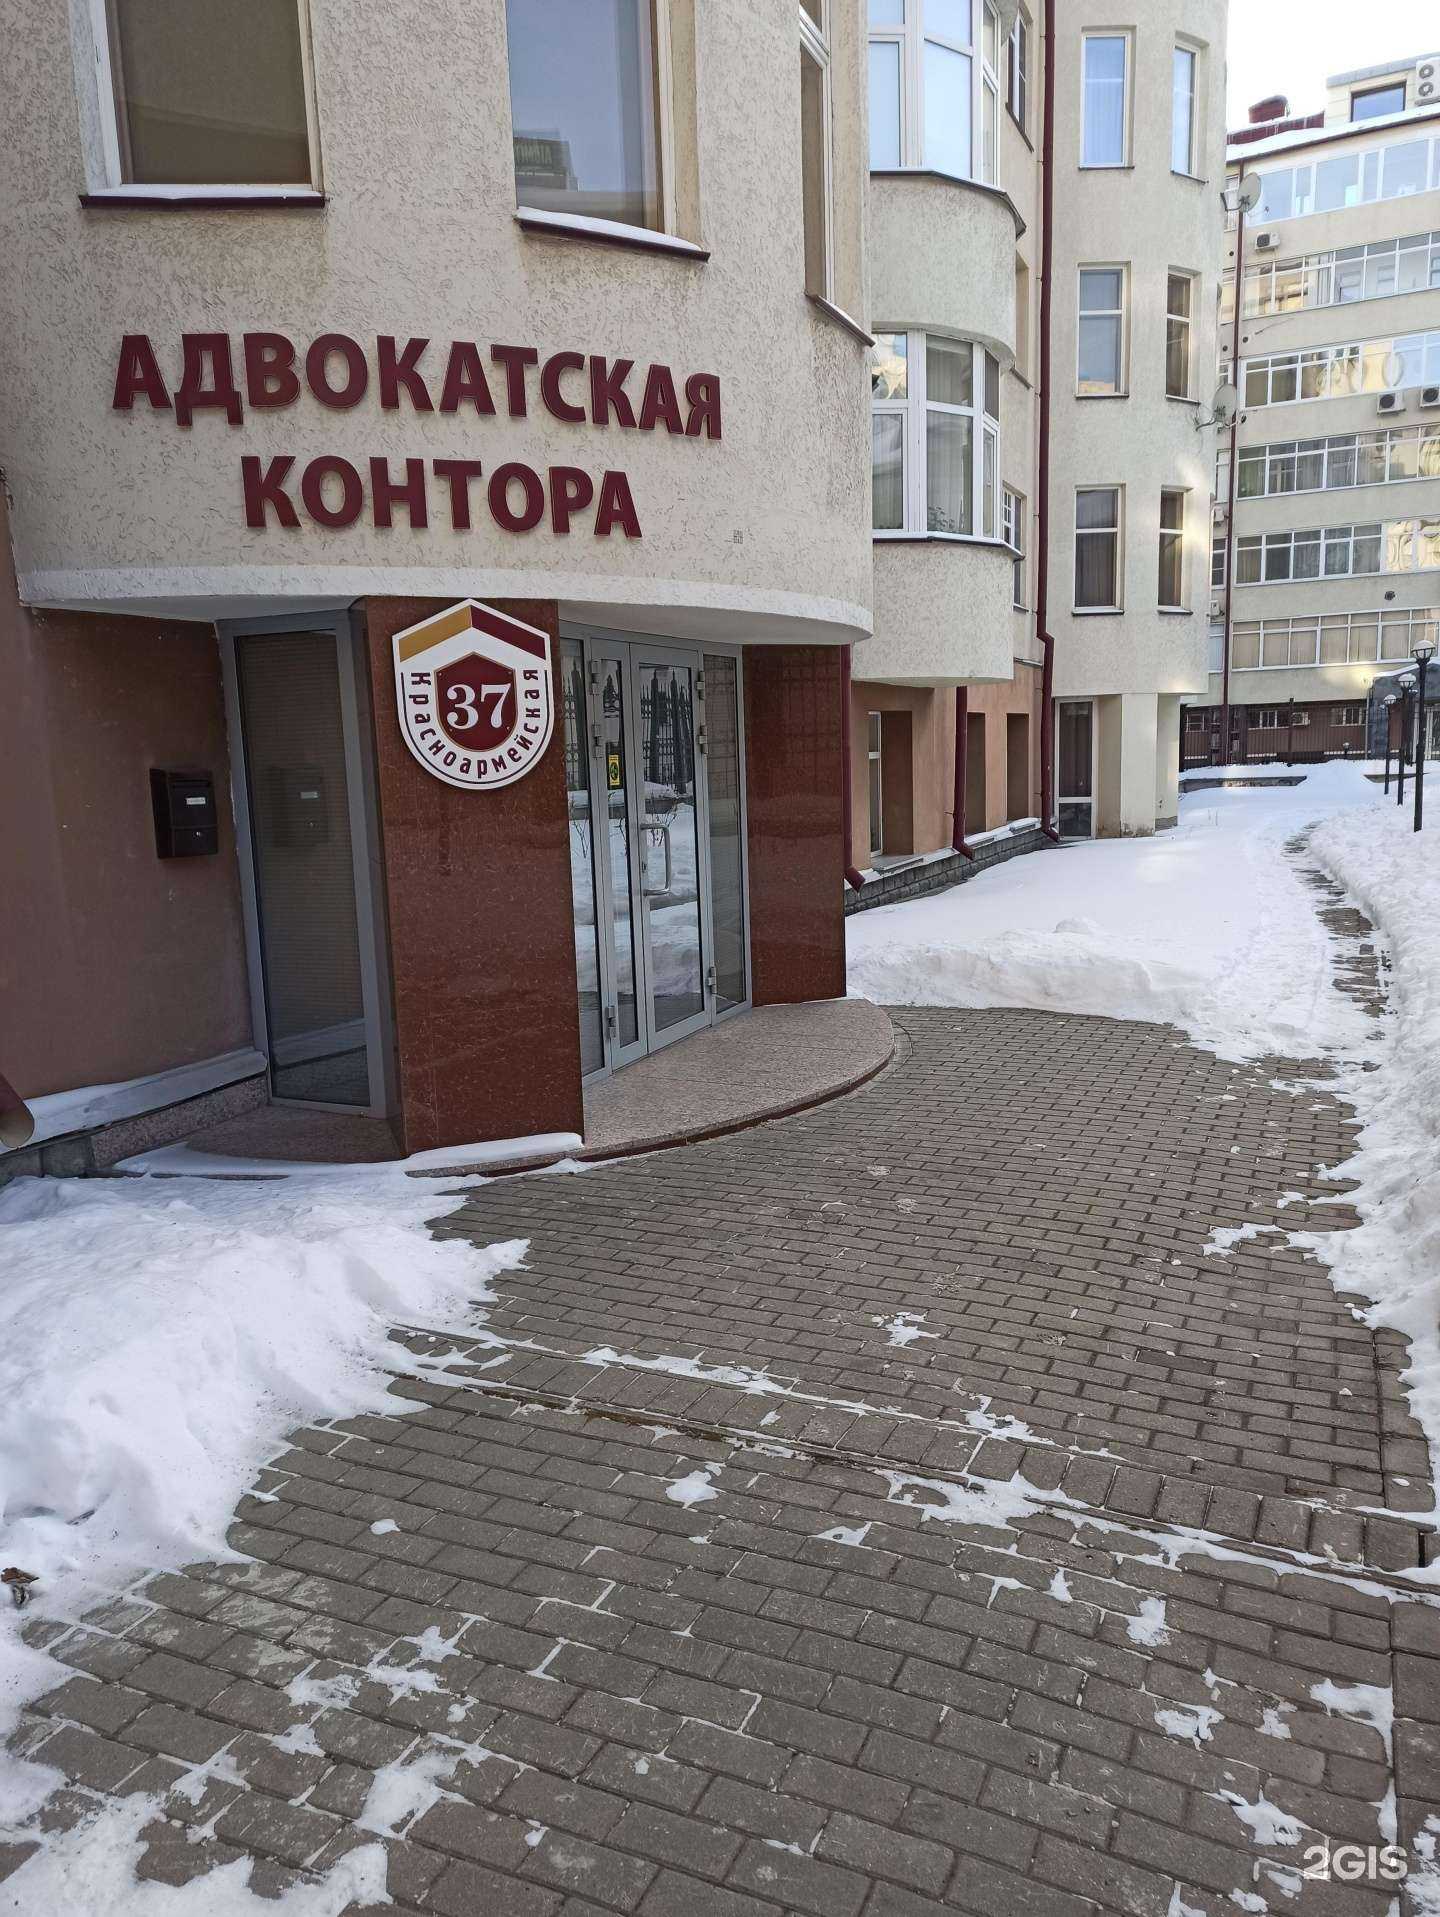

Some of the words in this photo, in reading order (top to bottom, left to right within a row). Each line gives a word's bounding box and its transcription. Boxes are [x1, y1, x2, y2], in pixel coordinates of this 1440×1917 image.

[112, 332, 722, 440] АДВОКАТСКАЯ
[241, 455, 643, 539] КОНТОРА
[446, 683, 512, 730] 37
